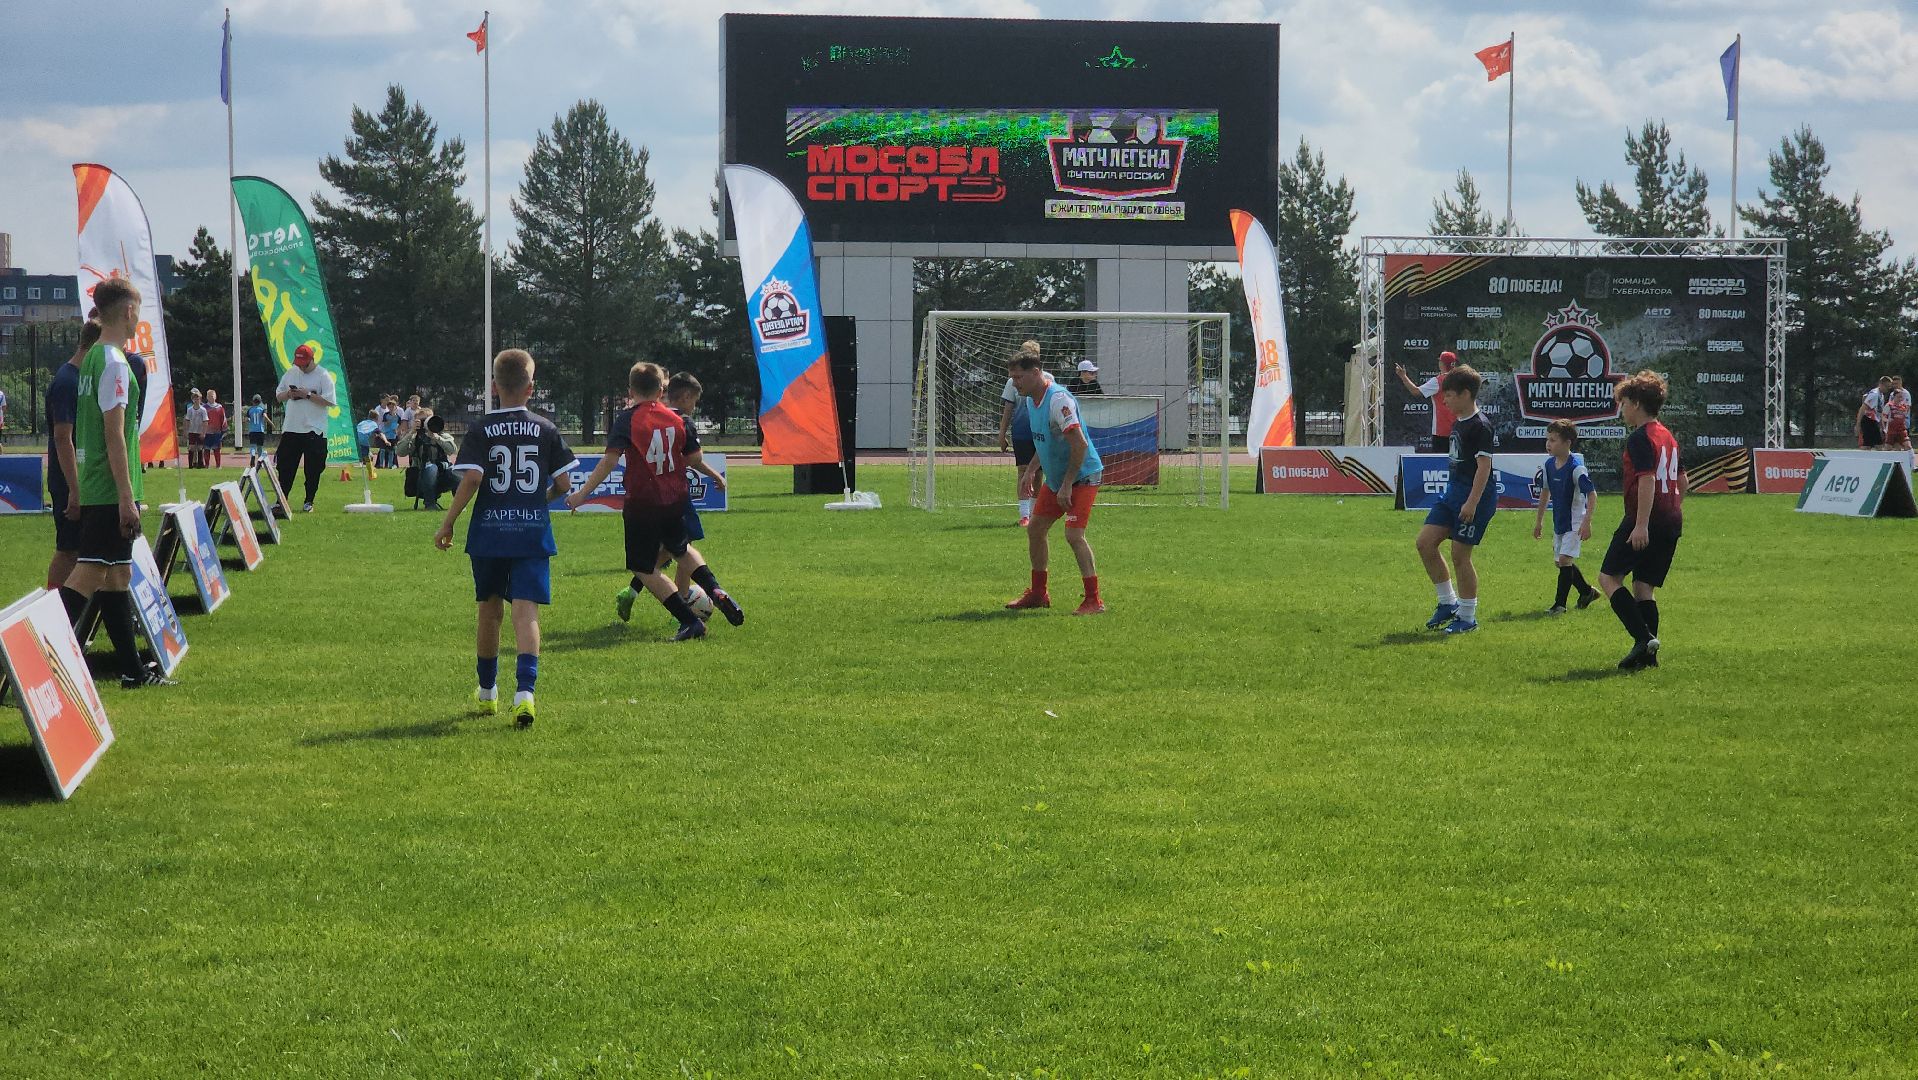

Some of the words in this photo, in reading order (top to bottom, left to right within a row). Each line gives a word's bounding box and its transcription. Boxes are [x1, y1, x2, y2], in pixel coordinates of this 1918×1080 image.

[808, 145, 999, 173] МОСОБЛ
[1062, 147, 1107, 167] МАТЧ
[1109, 148, 1170, 169] ЛЕГЕНД
[1066, 170, 1117, 179] ФУТБОЛА
[1118, 171, 1165, 180] РОССИИ
[808, 175, 957, 201] СПОРТ
[1060, 203, 1112, 214] ЖИТЕЛЯМИ
[1489, 277, 1507, 294] 80
[1510, 279, 1563, 294] ПОБЕДА!
[1688, 278, 1745, 287] МОСОБЛ
[1688, 288, 1732, 296] СПОРТ
[1699, 309, 1710, 319] 80
[1712, 310, 1745, 319] ПОБЕДА!
[1457, 340, 1468, 350] 80
[1469, 341, 1501, 350] ПОБЕДА!
[1697, 373, 1709, 383] 80
[1710, 374, 1744, 383] ПОБЕДА!
[1528, 382, 1562, 398] МАТЧ
[1565, 382, 1614, 399] ЛЕГЕНД
[1572, 401, 1611, 409] РОССИИ
[484, 422, 541, 438] КОСТЕНКО
[1525, 429, 1545, 437] ЖИТЕ
[1577, 429, 1624, 438] ДМОСКОВЬЯ
[1697, 436, 1709, 447] 80
[1710, 437, 1744, 447] ПОБЕДА!
[646, 426, 675, 475] 41
[488, 445, 540, 494] 35
[1272, 466, 1286, 479] 80
[1288, 467, 1329, 479] ПОБЕДА!
[1765, 466, 1780, 479] 80
[484, 509, 541, 521] ЗАРЕЧЬЕ
[1458, 524, 1475, 538] 28
